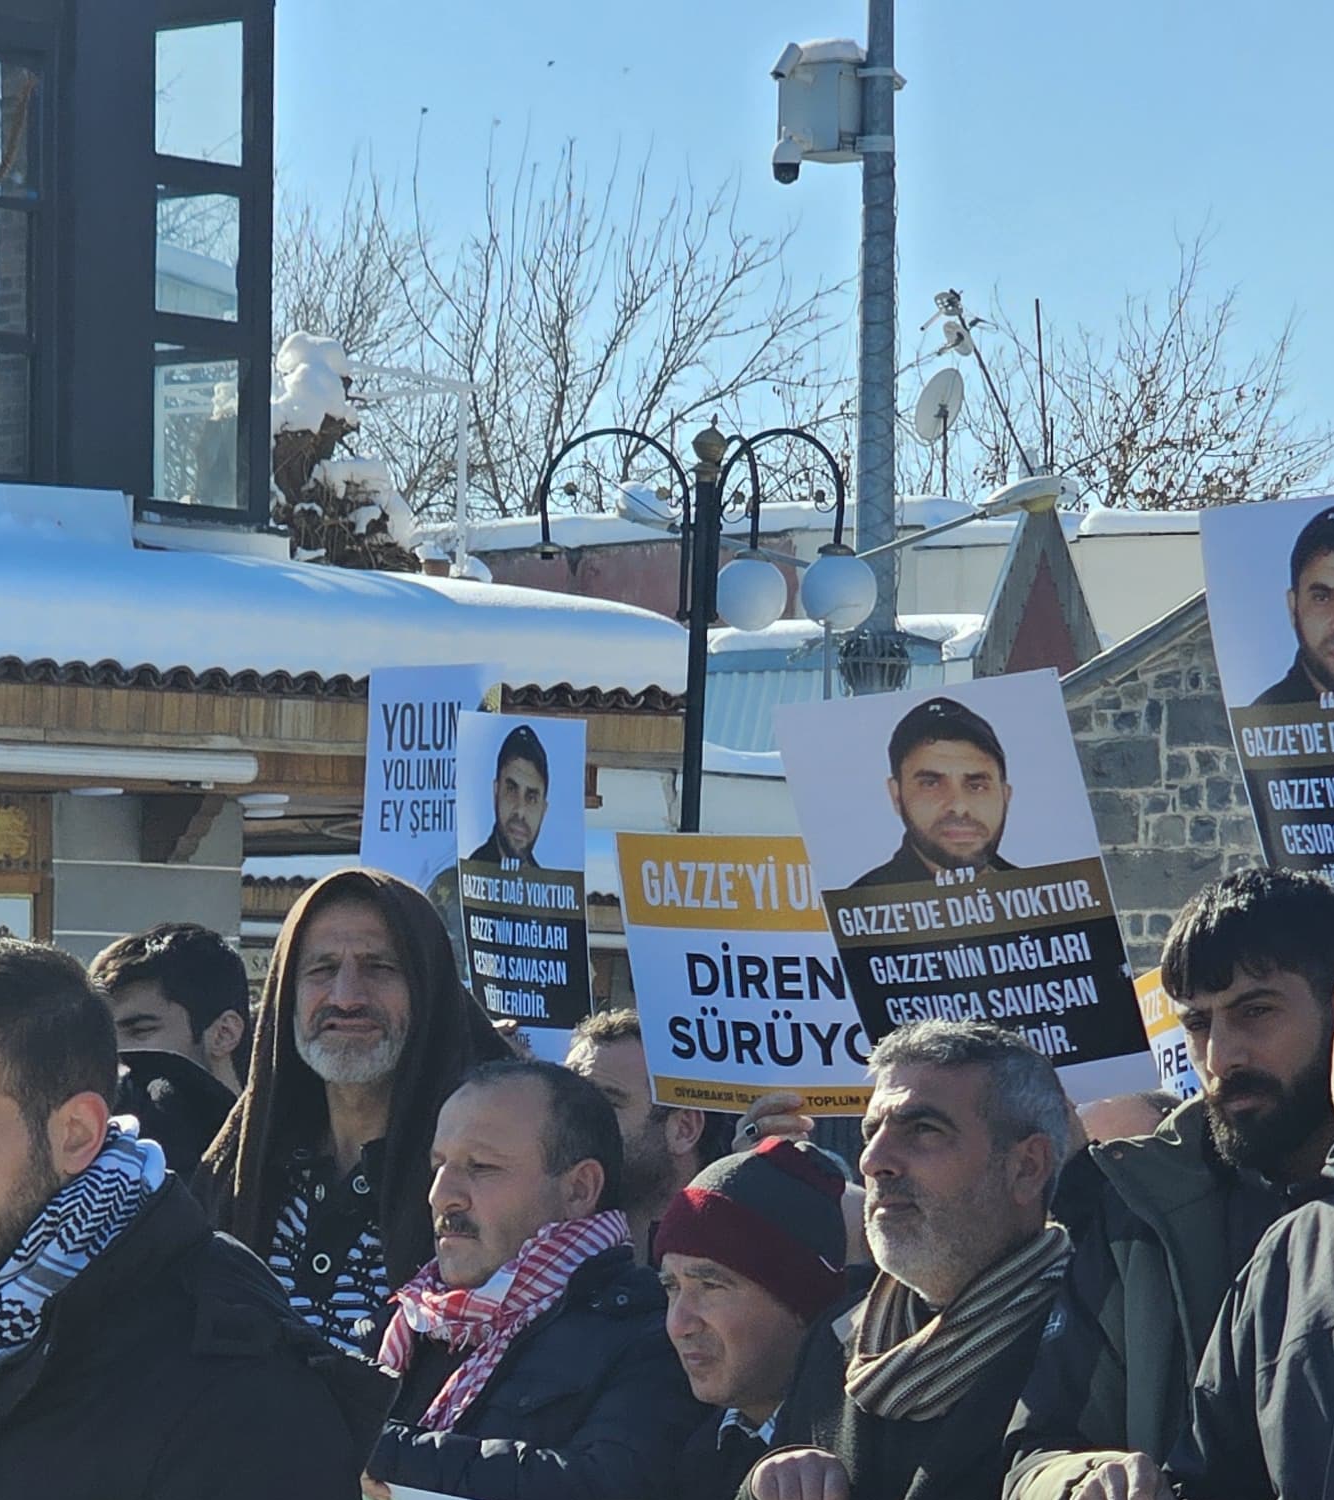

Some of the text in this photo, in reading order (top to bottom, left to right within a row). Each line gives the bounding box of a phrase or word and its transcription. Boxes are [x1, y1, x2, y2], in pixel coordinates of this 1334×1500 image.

[1242, 721, 1324, 758] GAZZE'DE
[380, 793, 457, 839] EY ŞEHİT
[502, 877, 524, 905] DAĞ
[526, 881, 580, 911] YOKTUR.
[641, 855, 780, 911] GAZZE'Yİ
[837, 879, 1100, 937] GAZZE'DE DAĞ YOKTUR.
[515, 919, 568, 950] DAĞLARI
[508, 954, 568, 989] SAVAŞAN
[685, 941, 847, 1000] DİREN
[869, 931, 1092, 986] GAZZE'NİN DAĞLARI
[987, 975, 1099, 1016] SAVAŞAN
